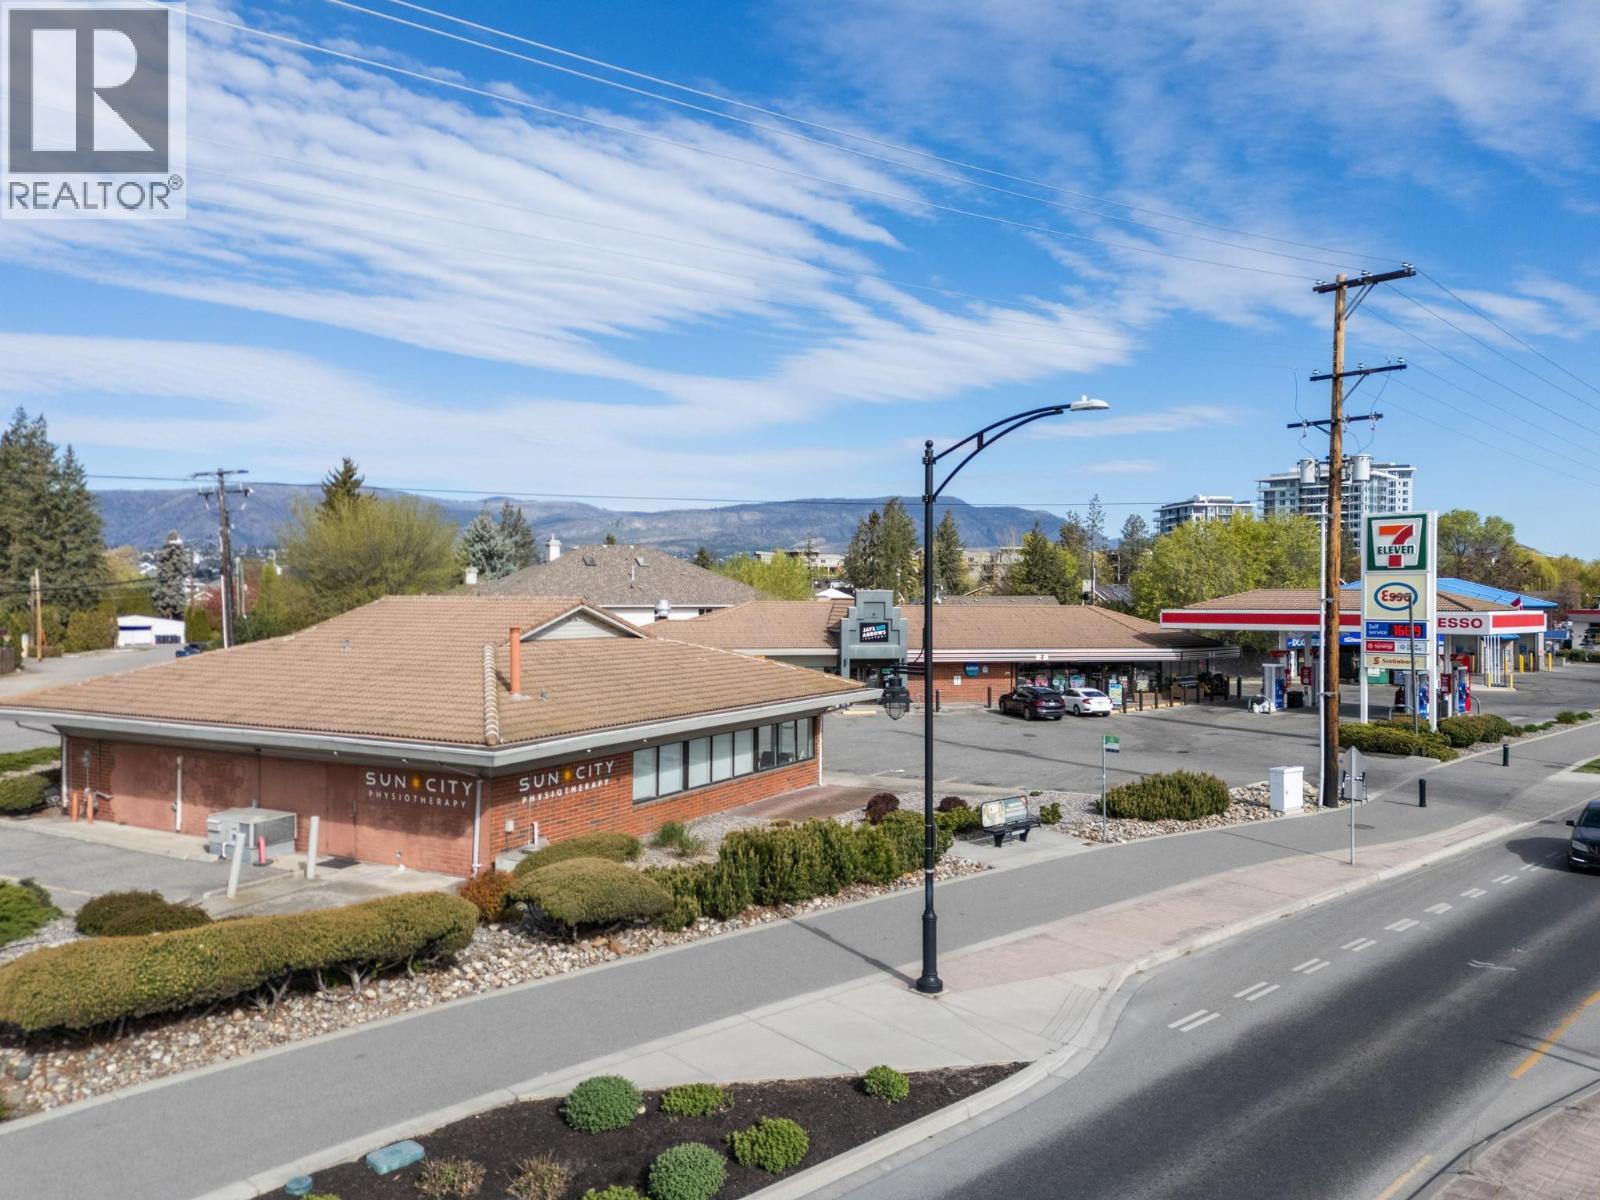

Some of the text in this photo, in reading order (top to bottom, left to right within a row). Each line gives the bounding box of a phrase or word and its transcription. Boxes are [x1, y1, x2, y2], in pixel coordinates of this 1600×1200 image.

[1381, 589, 1412, 602] Esso
[1437, 617, 1483, 629] ESSO
[365, 771, 474, 797] SUN CITY
[518, 759, 615, 793] SUN CITY
[368, 790, 468, 809] PHYSIOTHERAPY
[521, 779, 609, 804] PHYSIOTHERAPY
